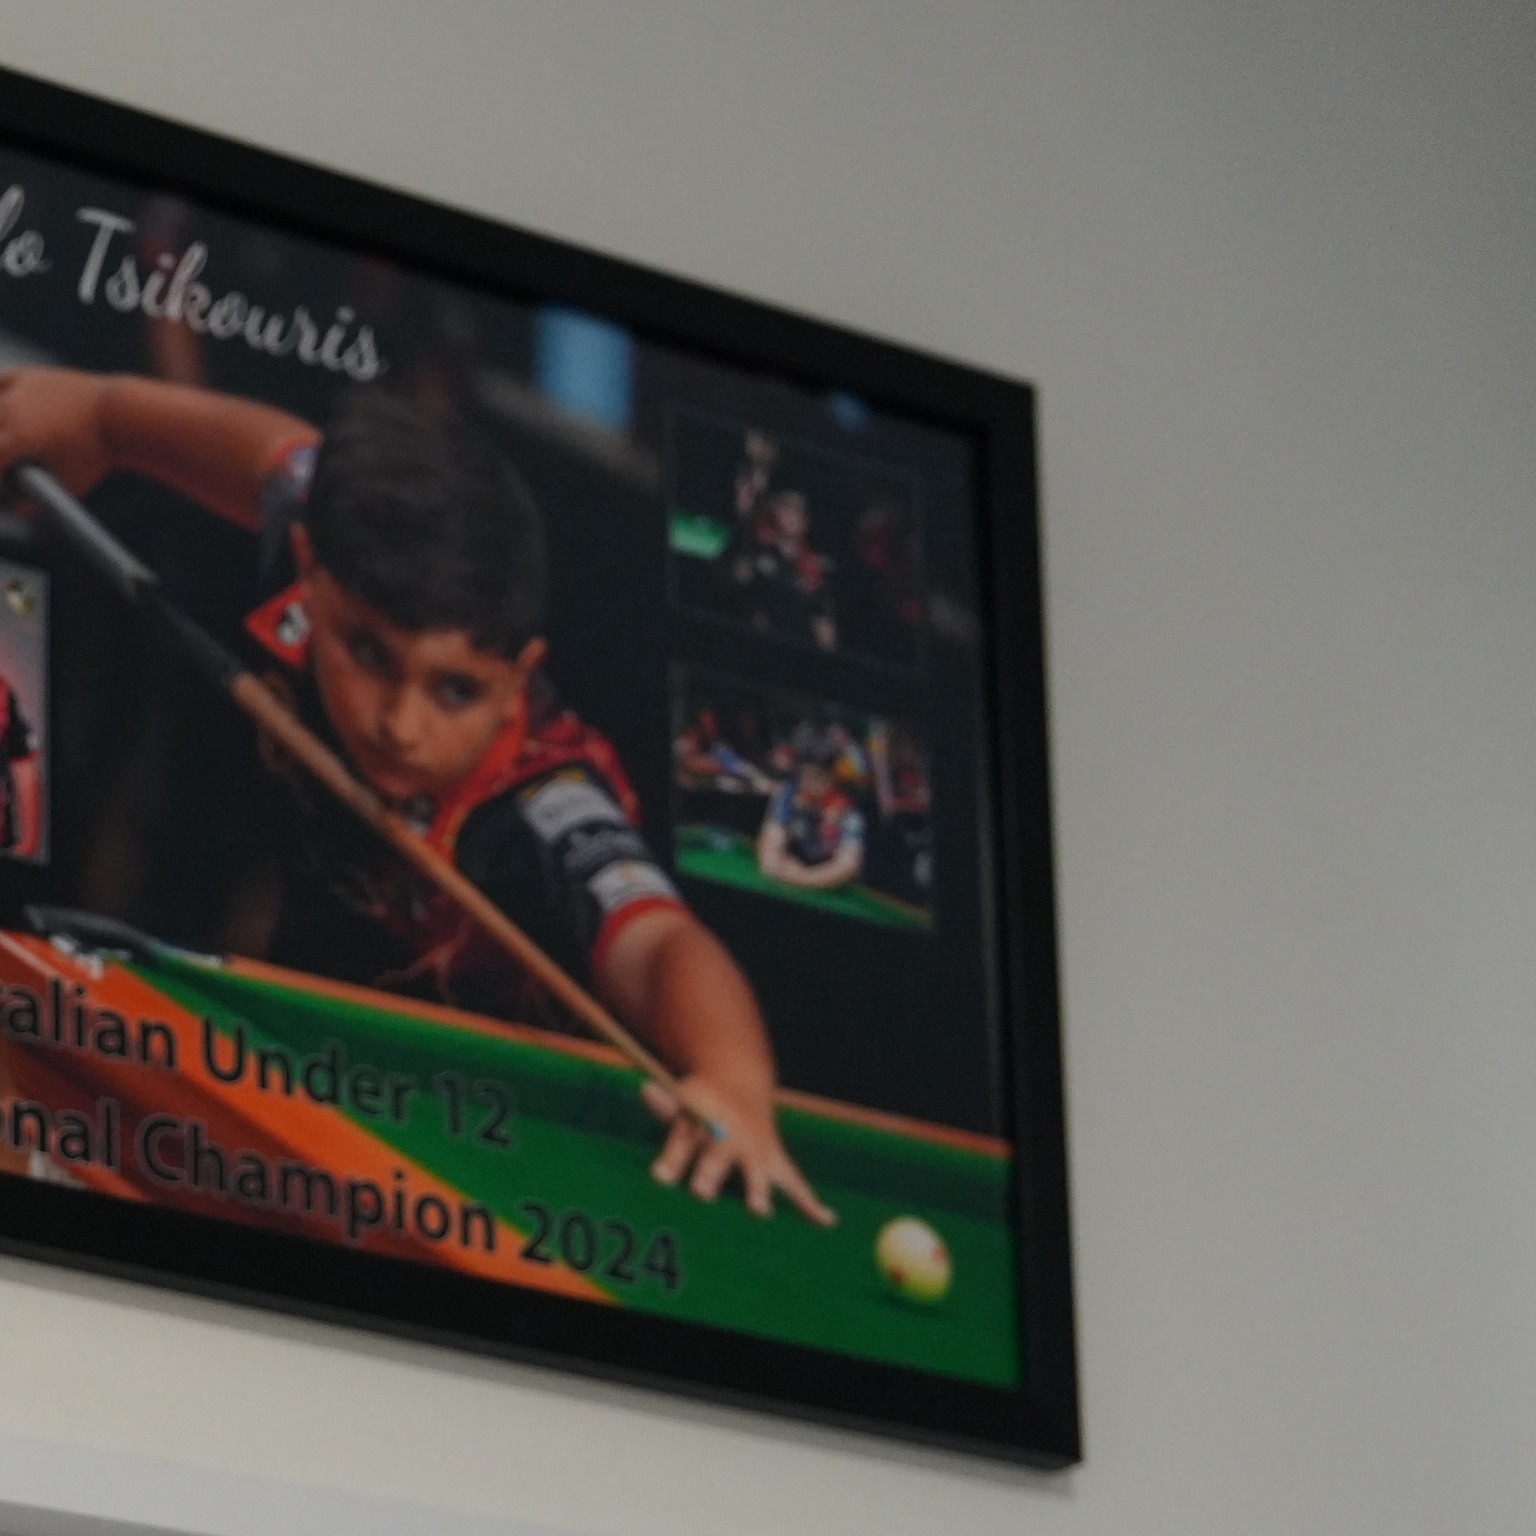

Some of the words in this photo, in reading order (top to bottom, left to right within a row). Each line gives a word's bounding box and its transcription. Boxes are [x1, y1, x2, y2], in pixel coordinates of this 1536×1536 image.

[76, 206, 390, 382] Tsikouris
[203, 1016, 415, 1124] Under
[435, 1076, 516, 1149] 12
[141, 1116, 499, 1255] Champion
[520, 1203, 683, 1291] 2024
